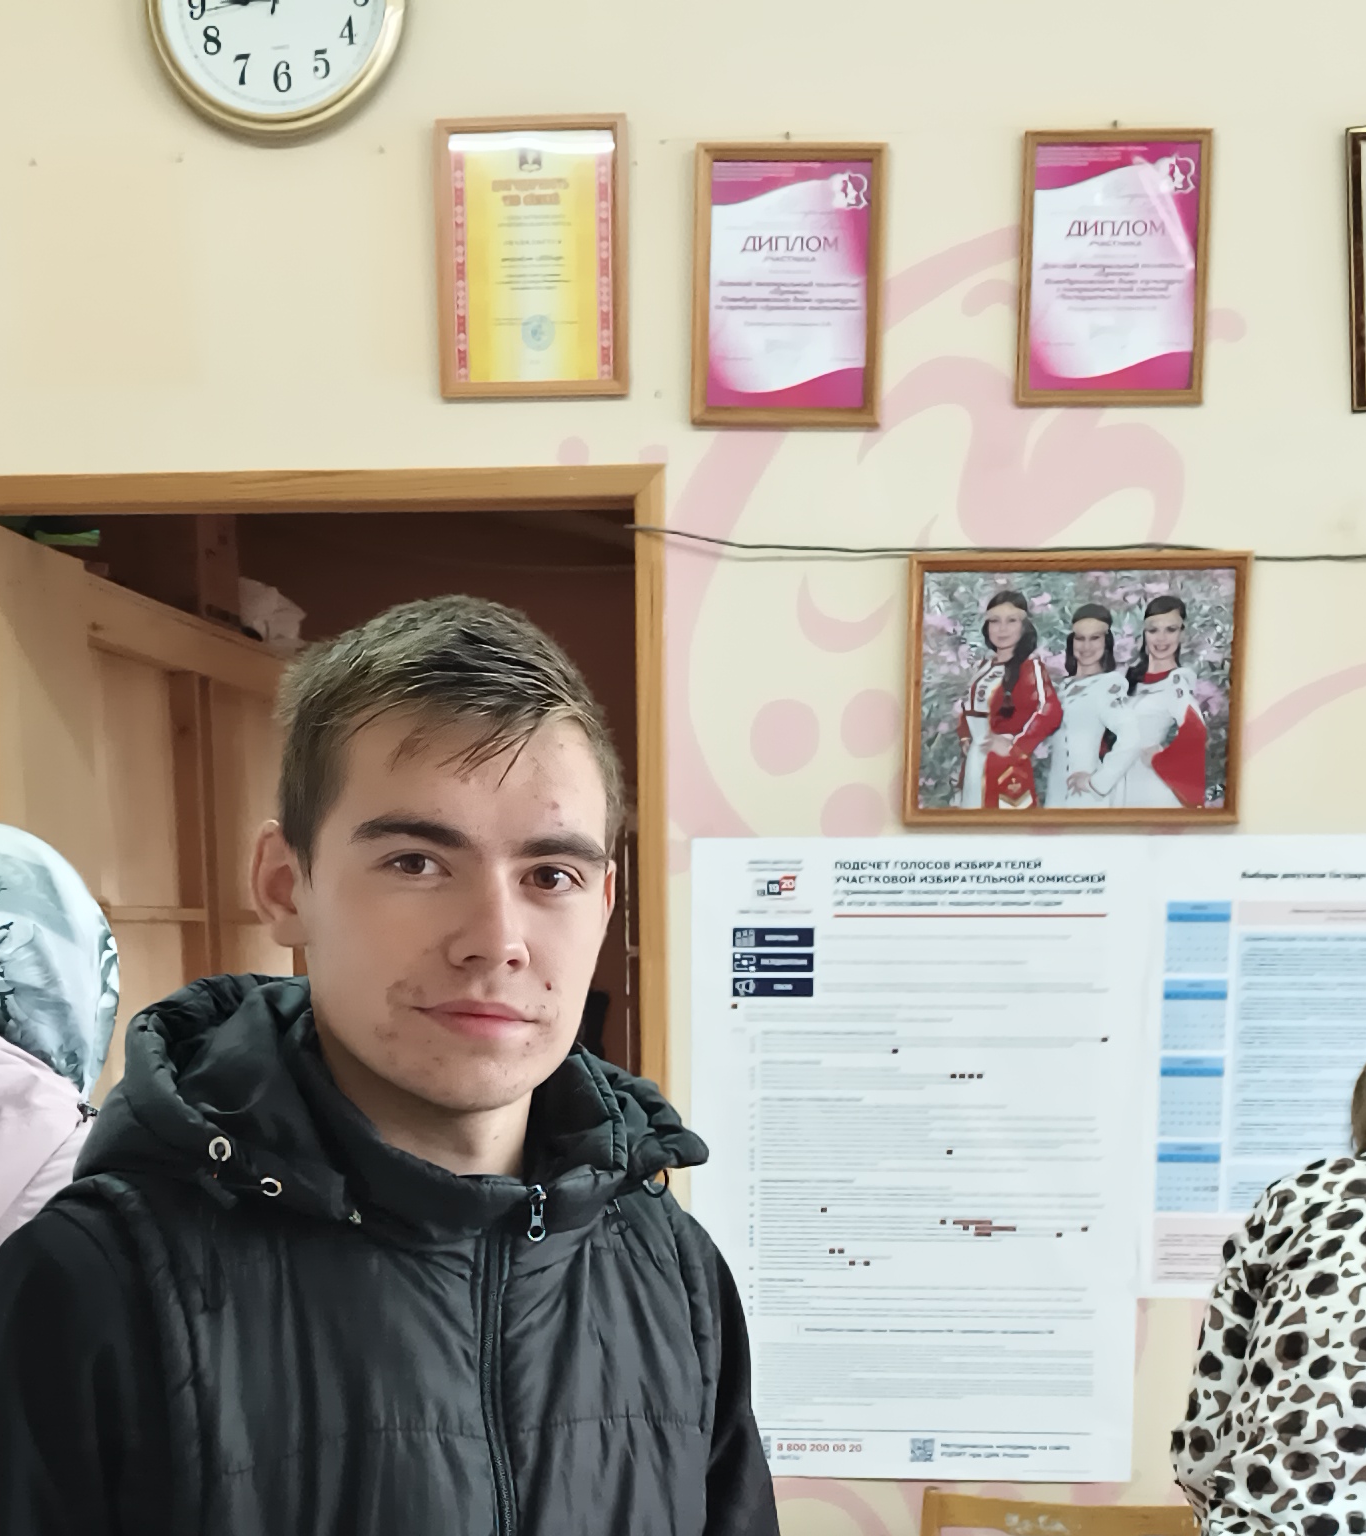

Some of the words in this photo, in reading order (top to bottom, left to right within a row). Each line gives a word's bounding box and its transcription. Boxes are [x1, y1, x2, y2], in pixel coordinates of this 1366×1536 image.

[188, 0, 205, 20] 9
[203, 26, 221, 55] 8
[340, 16, 356, 45] 4
[234, 54, 250, 85] 7
[314, 49, 330, 78] 5
[273, 61, 291, 92] 6
[1065, 220, 1165, 237] ДИПЛОМ
[742, 236, 839, 252] ДИПЛОМ
[835, 862, 889, 870] ПОДСЧЕТ
[837, 876, 915, 884] УЧАСТКОВОЙ
[1029, 875, 1105, 883] КОМИССИЕЙ
[810, 1444, 829, 1452] 200
[833, 1444, 846, 1452] 00
[849, 1444, 862, 1452] 20
